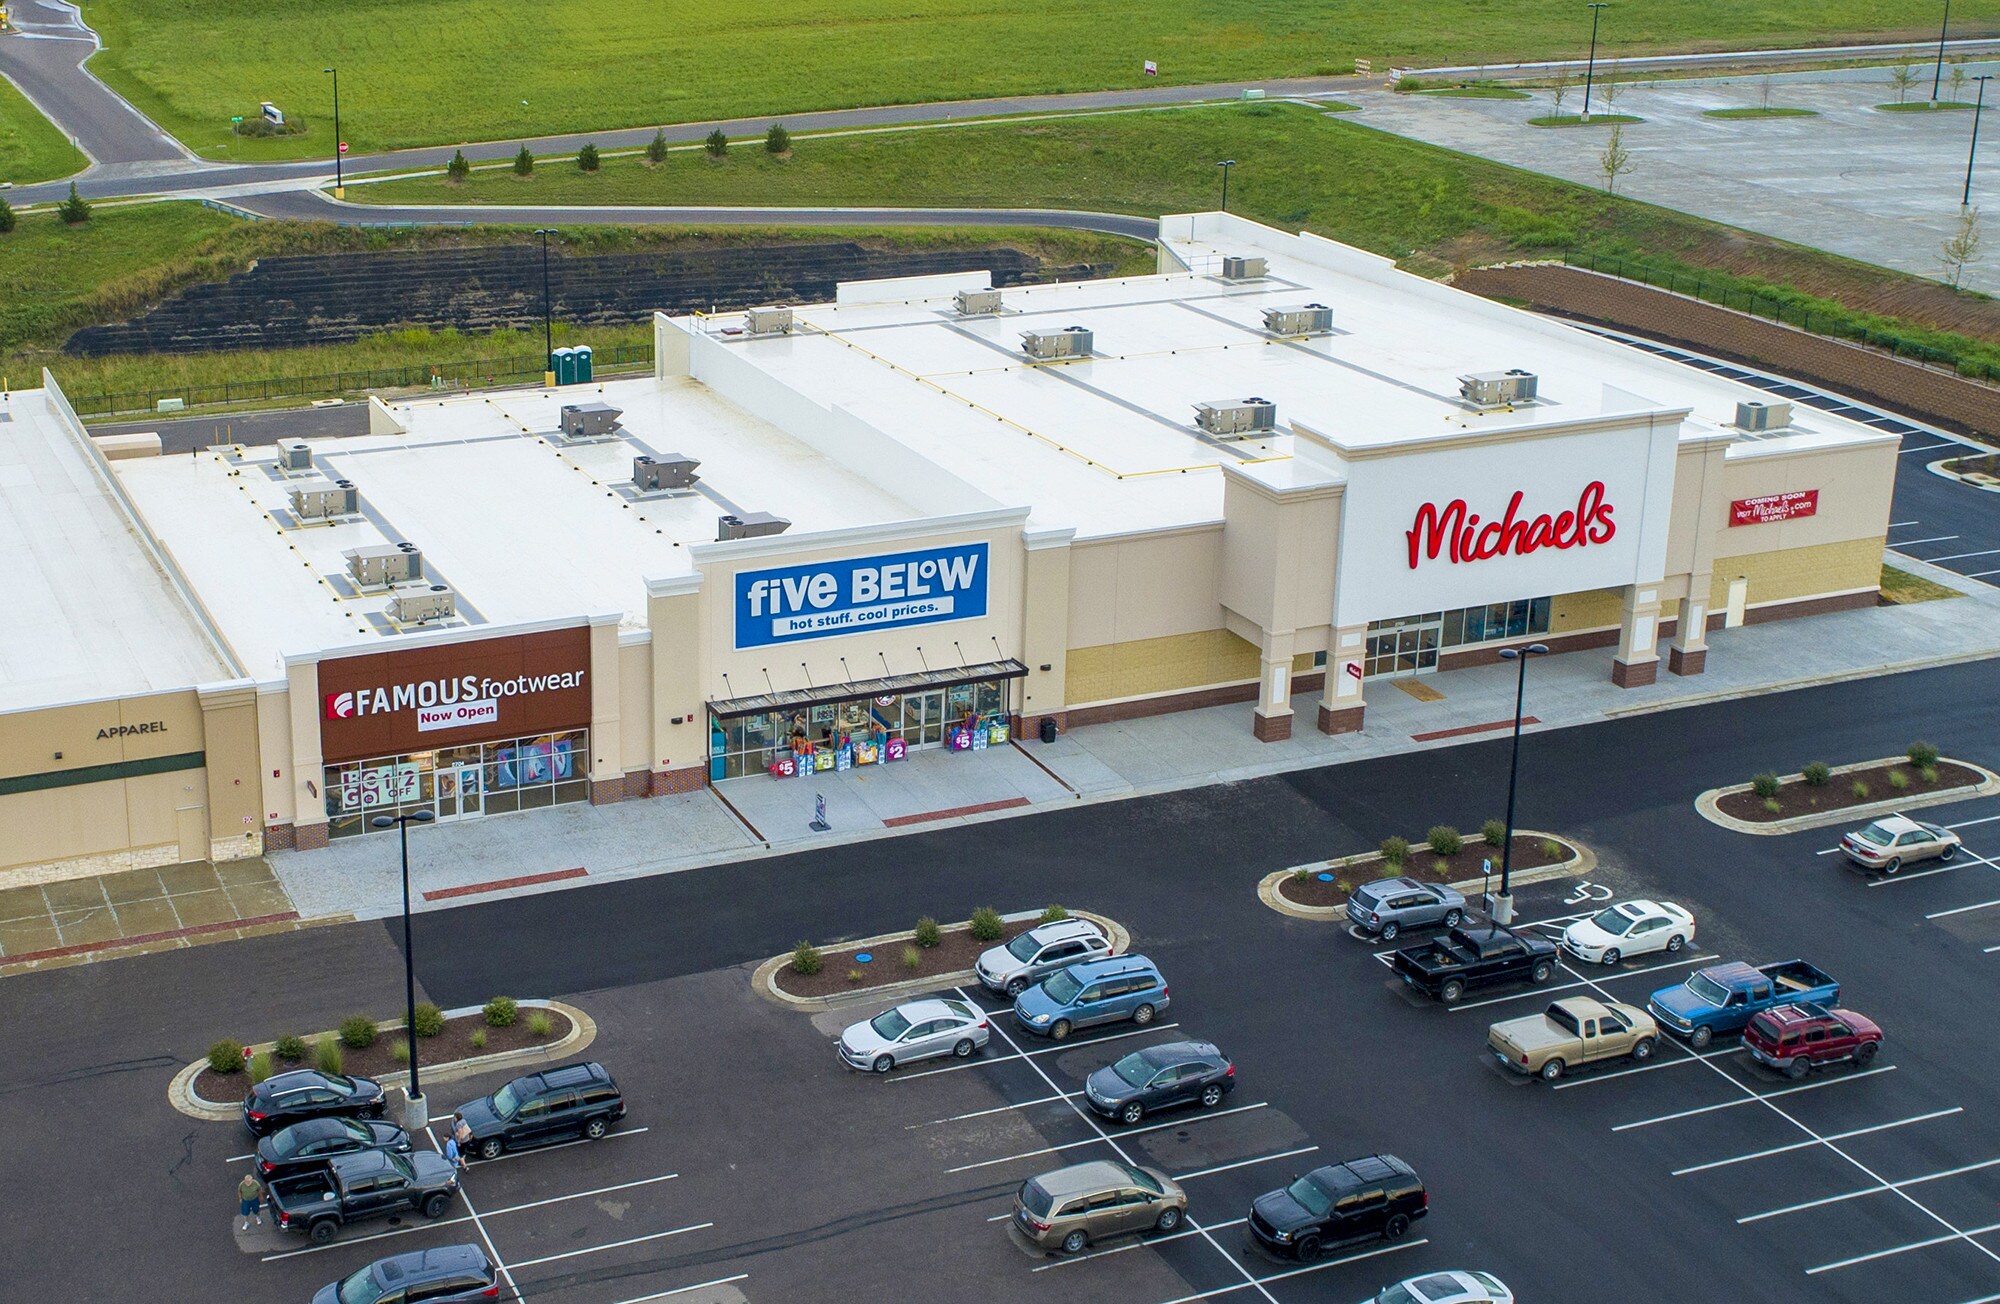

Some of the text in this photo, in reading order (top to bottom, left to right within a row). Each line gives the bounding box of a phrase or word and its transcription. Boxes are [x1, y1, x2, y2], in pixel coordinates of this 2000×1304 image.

[1744, 491, 1806, 506] COMING SOON
[1405, 480, 1616, 570] Michaels
[1769, 513, 1787, 521] APPLY
[747, 572, 838, 617] five
[789, 603, 939, 630] hot stuff. cool prices.
[356, 670, 585, 716] FAMOUS footwear
[420, 705, 494, 723] Now Open
[96, 721, 168, 740] APPAREL
[955, 735, 970, 749] $5
[889, 745, 904, 759] $2
[778, 762, 794, 775] $5
[388, 786, 411, 798] OFF
